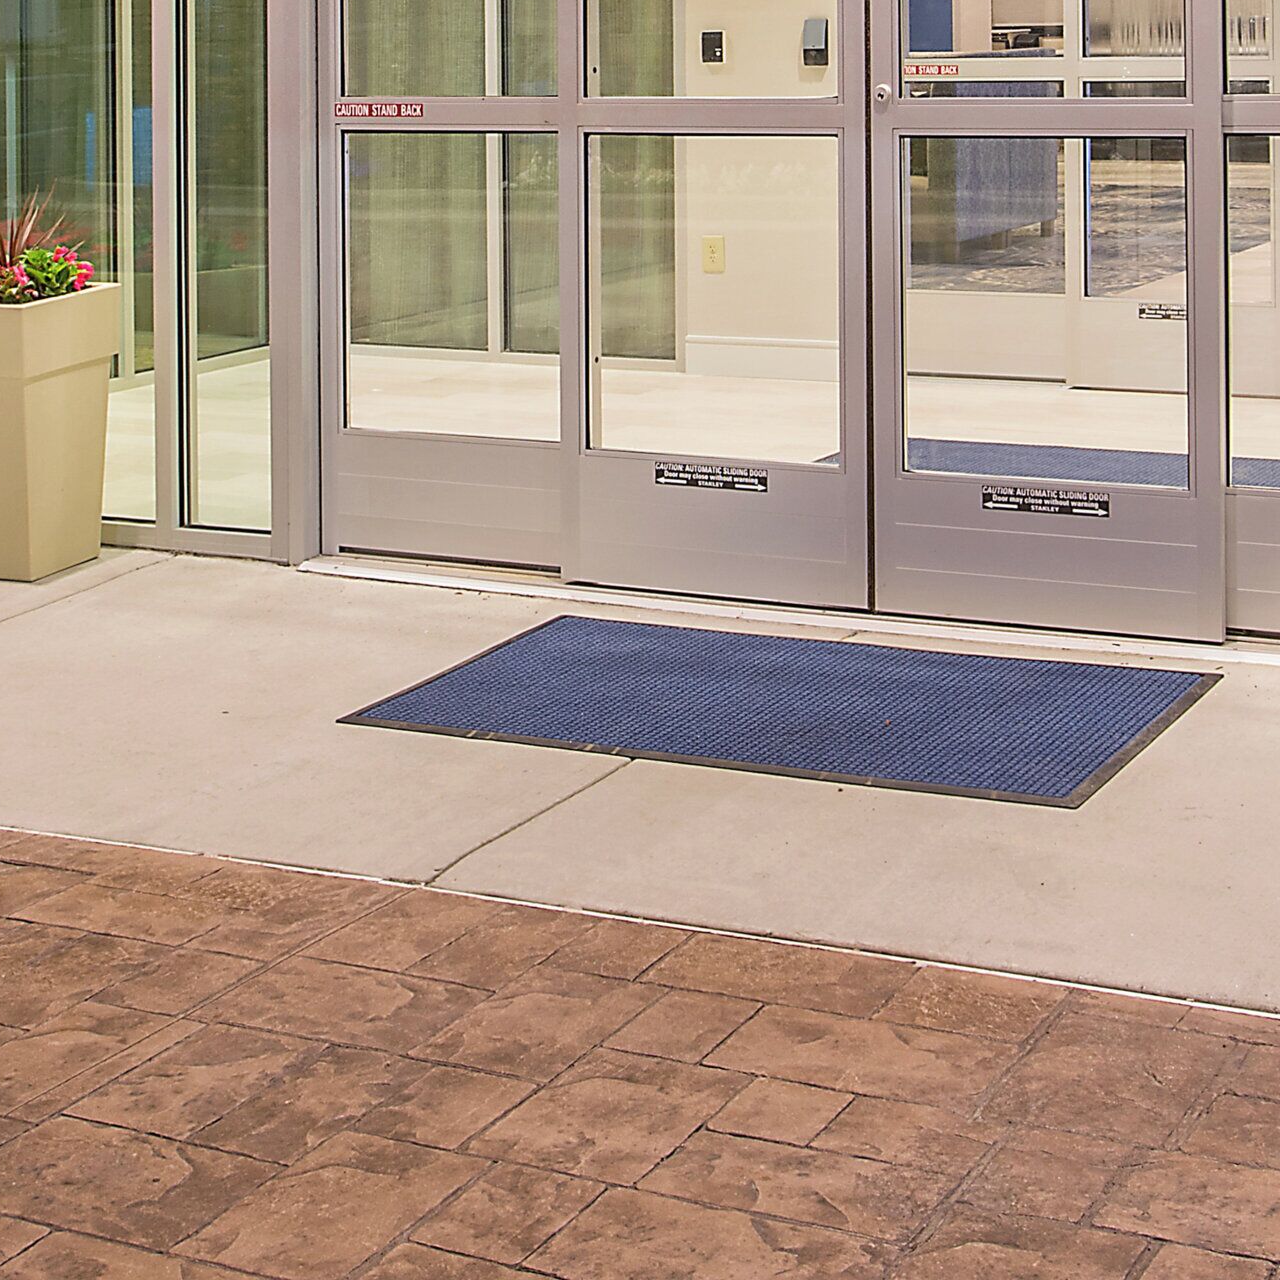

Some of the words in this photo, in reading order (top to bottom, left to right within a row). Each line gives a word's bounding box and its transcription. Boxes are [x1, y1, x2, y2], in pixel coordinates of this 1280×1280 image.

[918, 66, 939, 75] STAND
[940, 66, 957, 75] BACK
[336, 104, 369, 116] CAUTION
[372, 104, 398, 116] STAND
[400, 104, 422, 116] BACK
[685, 464, 722, 474] AUTOMATIC
[723, 467, 749, 476] SLIDING
[749, 469, 768, 478] DOOR
[992, 494, 1008, 502] Door
[1009, 496, 1023, 504] may
[1024, 497, 1042, 505] close
[1044, 498, 1070, 506] without
[1070, 500, 1099, 509] warning
[1016, 488, 1058, 498] AUTOMATIC
[1059, 491, 1087, 500] SLIDING
[1088, 493, 1109, 502] DOOR
